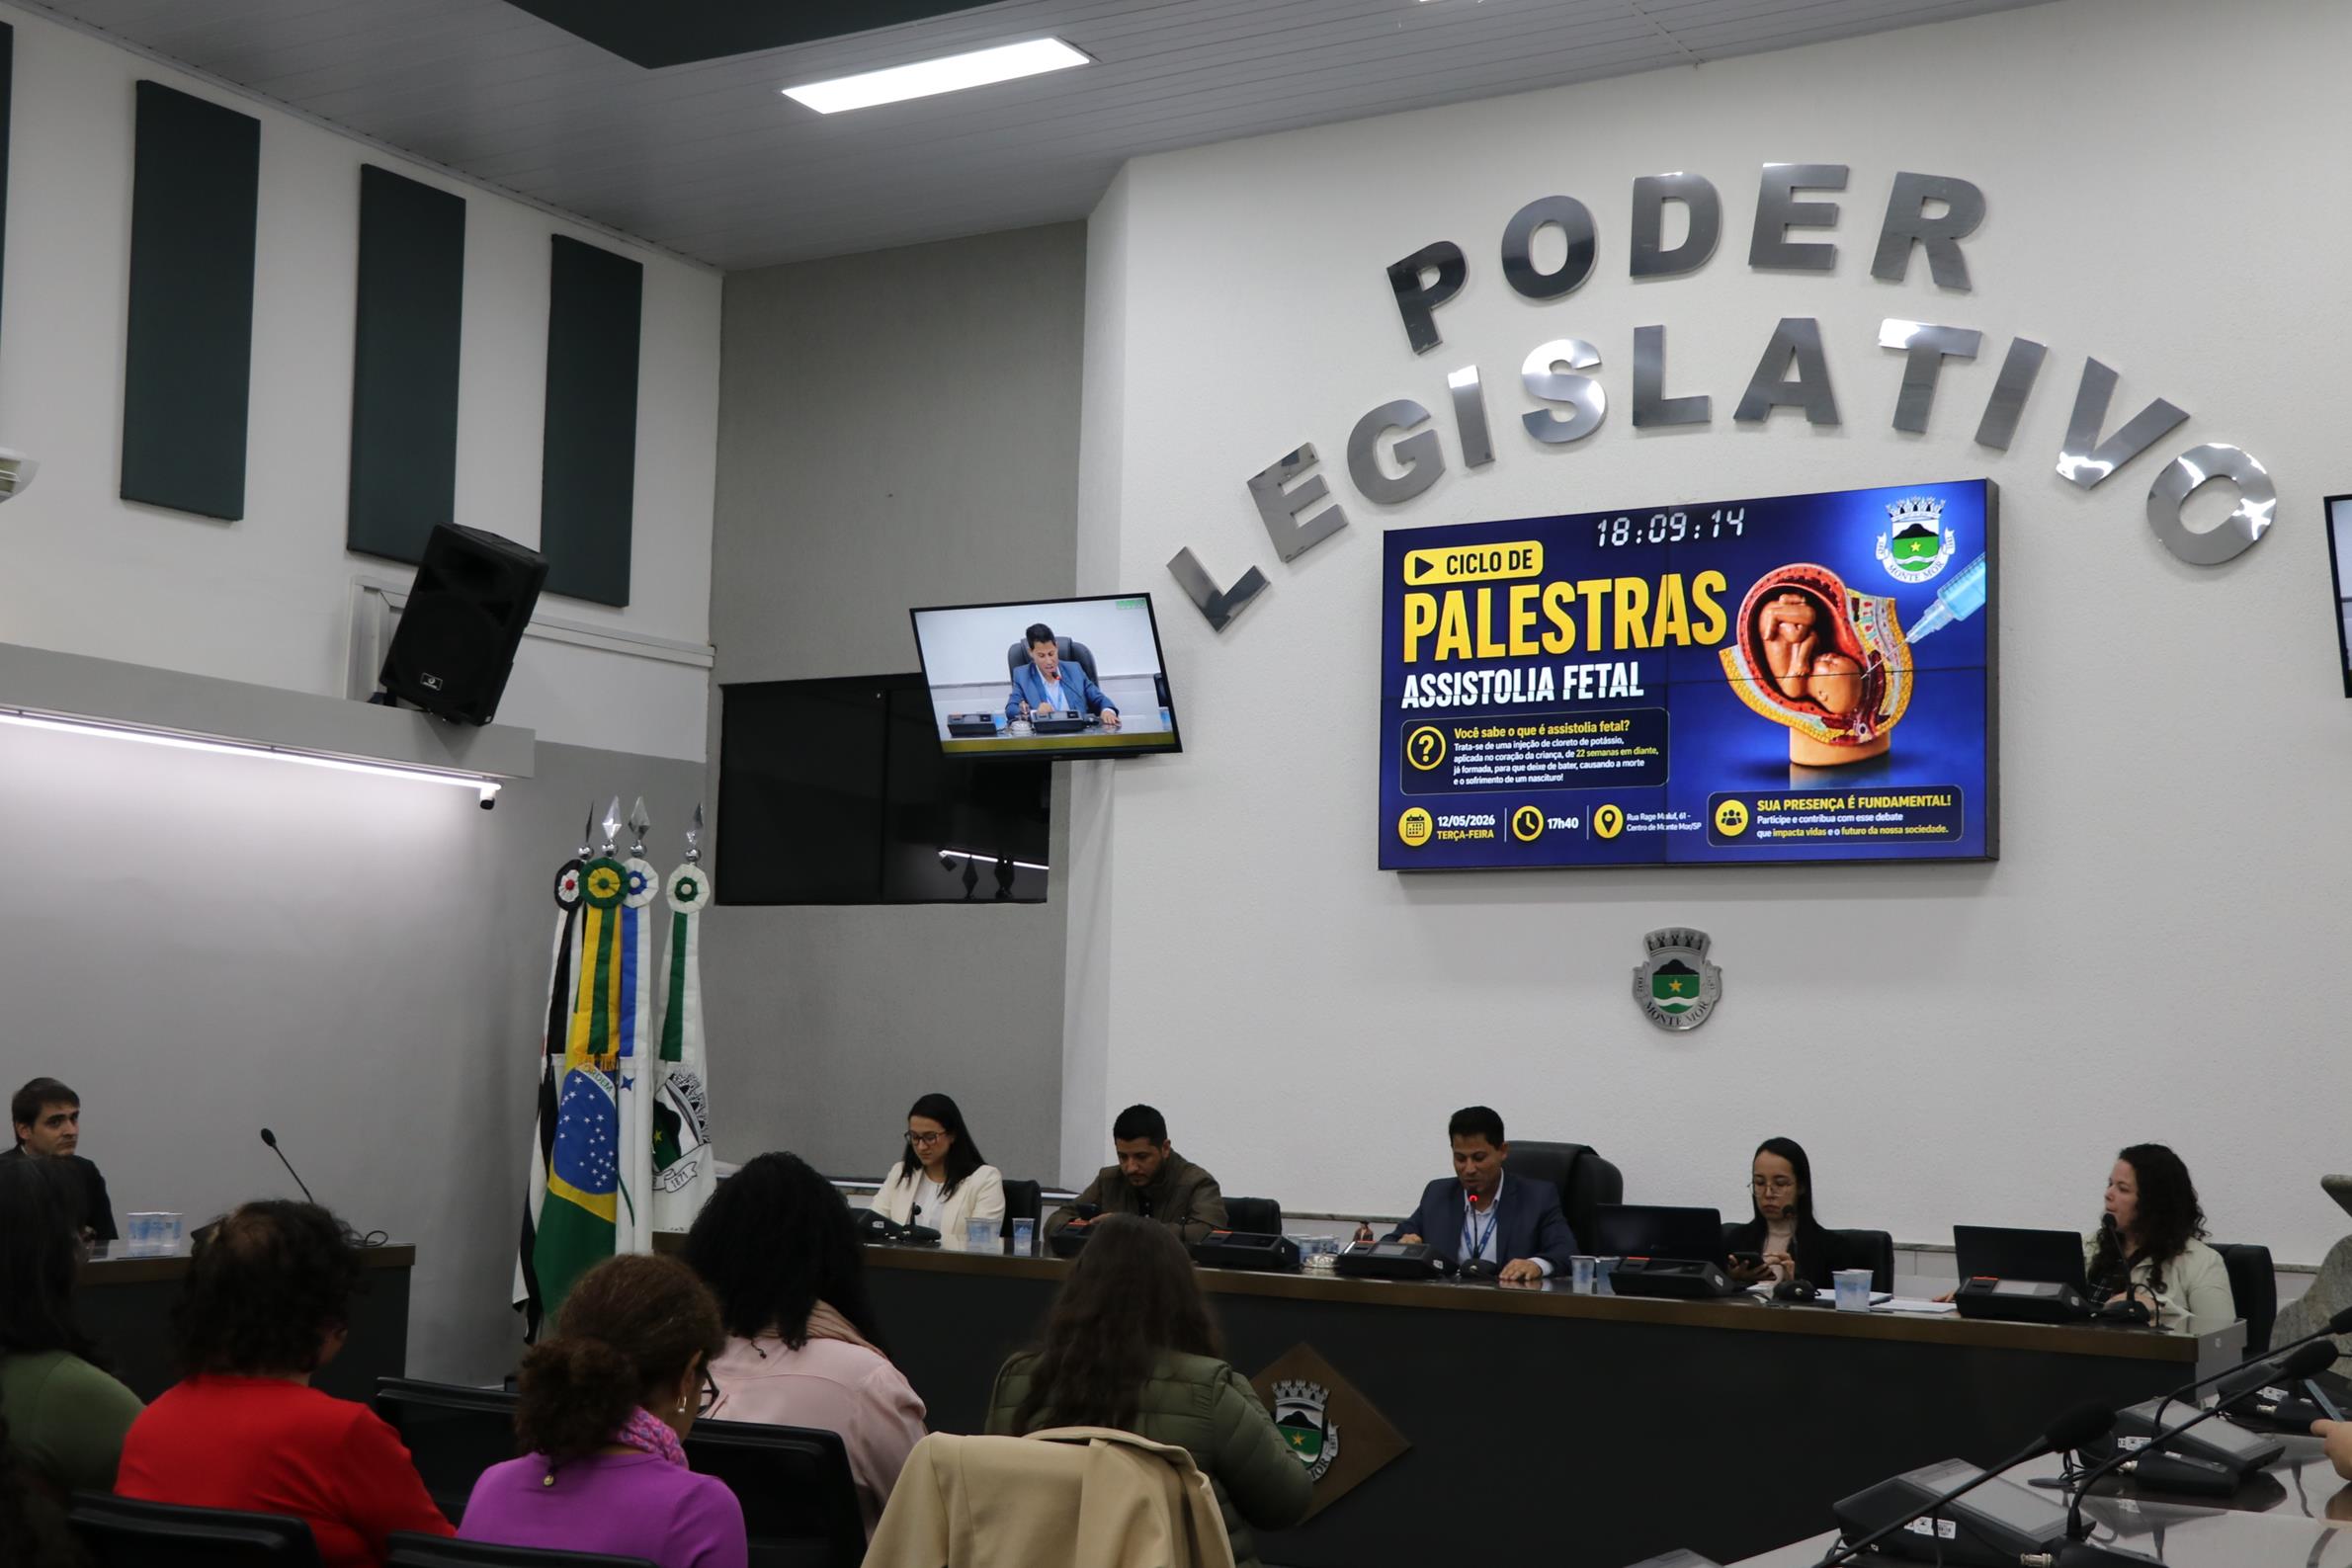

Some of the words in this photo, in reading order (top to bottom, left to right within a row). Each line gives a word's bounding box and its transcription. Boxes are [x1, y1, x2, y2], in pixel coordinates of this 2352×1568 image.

[1386, 162, 1986, 355] PODER
[1164, 316, 2277, 633] LEGISLATIVO
[1597, 507, 1745, 547] 18:09:14
[1446, 550, 1502, 575] CICLO
[1508, 548, 1533, 571] DE
[1888, 564, 1920, 582] MONTE
[1922, 560, 1945, 578] MOR
[1403, 570, 1727, 663] PALESTRAS
[1400, 666, 1555, 709] ASSISTOLIA
[1562, 661, 1644, 701] FETAL
[1454, 726, 1479, 739] Você
[1481, 725, 1506, 738] sabe
[1508, 727, 1515, 737] o
[1517, 726, 1537, 739] que
[1539, 723, 1546, 735] é
[1548, 721, 1597, 735] assistolia
[1599, 719, 1631, 732] fetal?
[1454, 742, 1483, 752] Trata-se
[1484, 741, 1494, 750] de
[1513, 739, 1540, 751] injeção
[1541, 738, 1551, 748] de
[1552, 738, 1578, 747] cloreto
[1579, 737, 1589, 746] de
[1454, 753, 1483, 765] aplicada
[1495, 751, 1524, 762] coração
[1525, 751, 1534, 760] da
[1536, 750, 1563, 761] criança,
[1565, 749, 1575, 759] de
[1576, 749, 1585, 758] 22
[1634, 746, 1659, 755] diante,
[1453, 765, 1461, 776] já
[1462, 764, 1493, 774] formada,
[1494, 765, 1510, 774] para
[1512, 765, 1526, 774] que
[1527, 762, 1546, 772] deixe
[1547, 762, 1556, 771] de
[1557, 761, 1578, 771] bater,
[1579, 759, 1615, 769] causando
[1622, 759, 1644, 768] morte
[1466, 775, 1503, 784] sofrimento
[1505, 775, 1514, 784] de
[1528, 773, 1563, 783] nascituro!
[1757, 799, 1781, 811] SUA
[1783, 797, 1845, 812] PRESENÇA
[1848, 794, 1855, 809] É
[1858, 794, 1952, 808] FUNDAMENTAL!
[1437, 814, 1496, 827] 12/05/2026
[1547, 817, 1579, 830] 17h40
[1627, 812, 1639, 821] Rua
[1757, 815, 1791, 826] Participe
[1799, 814, 1835, 823] contribua
[1875, 812, 1903, 821] debate
[1437, 829, 1494, 841] TERÇA-FEIRA
[1657, 822, 1678, 831] Monte
[1678, 821, 1702, 831] Mor/SP
[1756, 830, 1772, 839] que
[1773, 828, 1805, 838] impacta
[1806, 827, 1826, 836] vidas
[1841, 826, 1867, 835] futuro
[1868, 826, 1878, 835] da
[1904, 824, 1949, 834] sociedade.
[1646, 1001, 1682, 1026] MONTE
[1685, 1000, 1709, 1022] MOR
[671, 1171, 689, 1189] 1871
